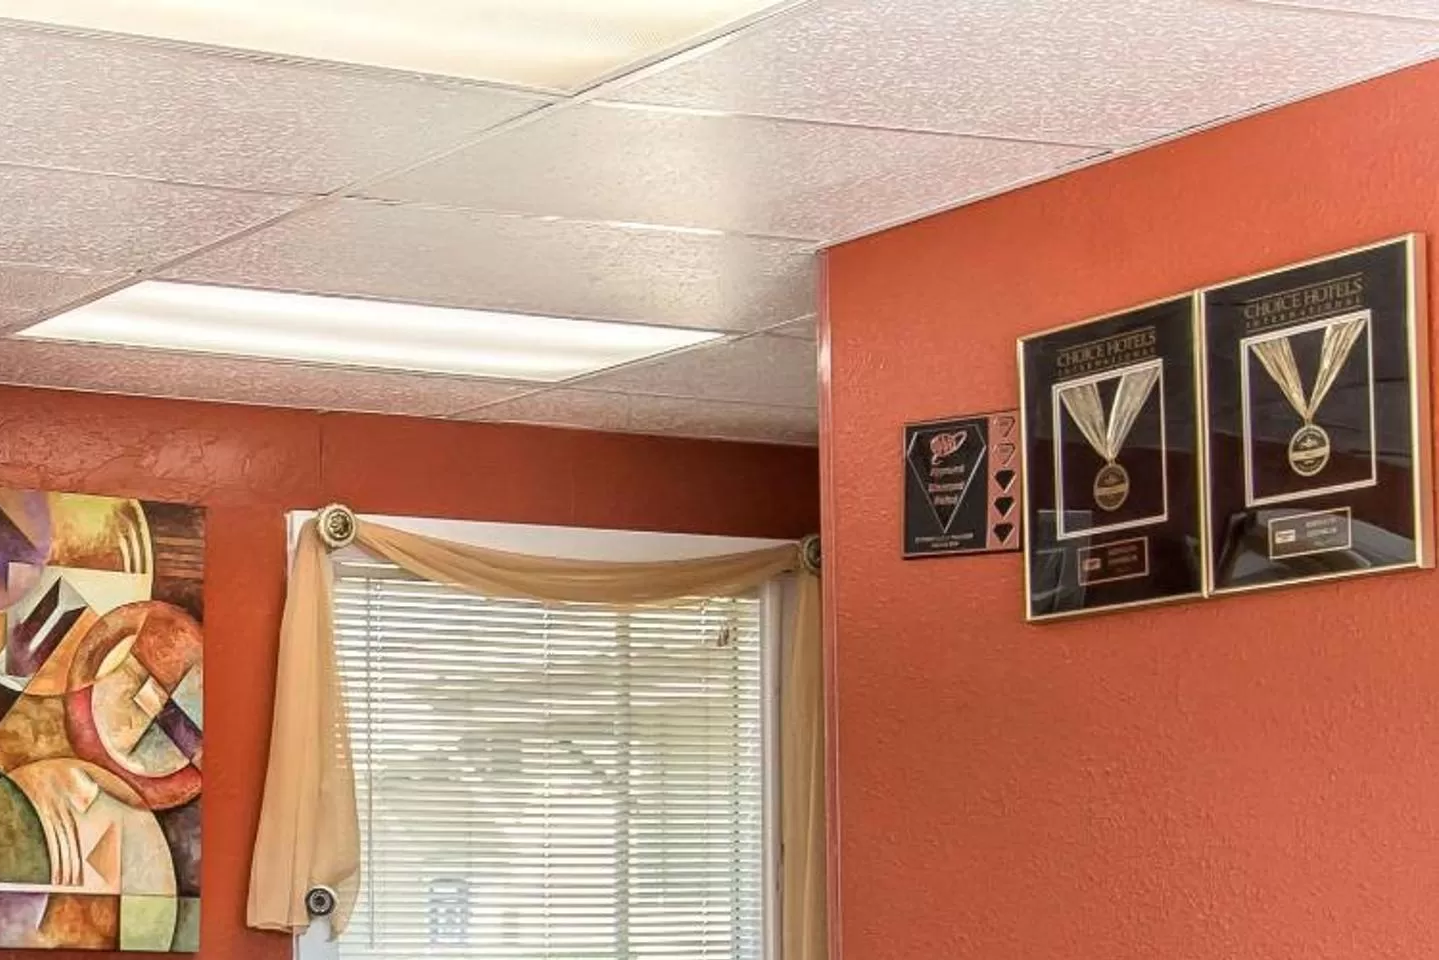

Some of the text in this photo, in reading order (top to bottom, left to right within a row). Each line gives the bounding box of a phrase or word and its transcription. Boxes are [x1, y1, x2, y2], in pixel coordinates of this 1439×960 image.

[1244, 278, 1363, 319] CHOICE HOTELS
[1057, 334, 1156, 368] CHOICE HOTELS
